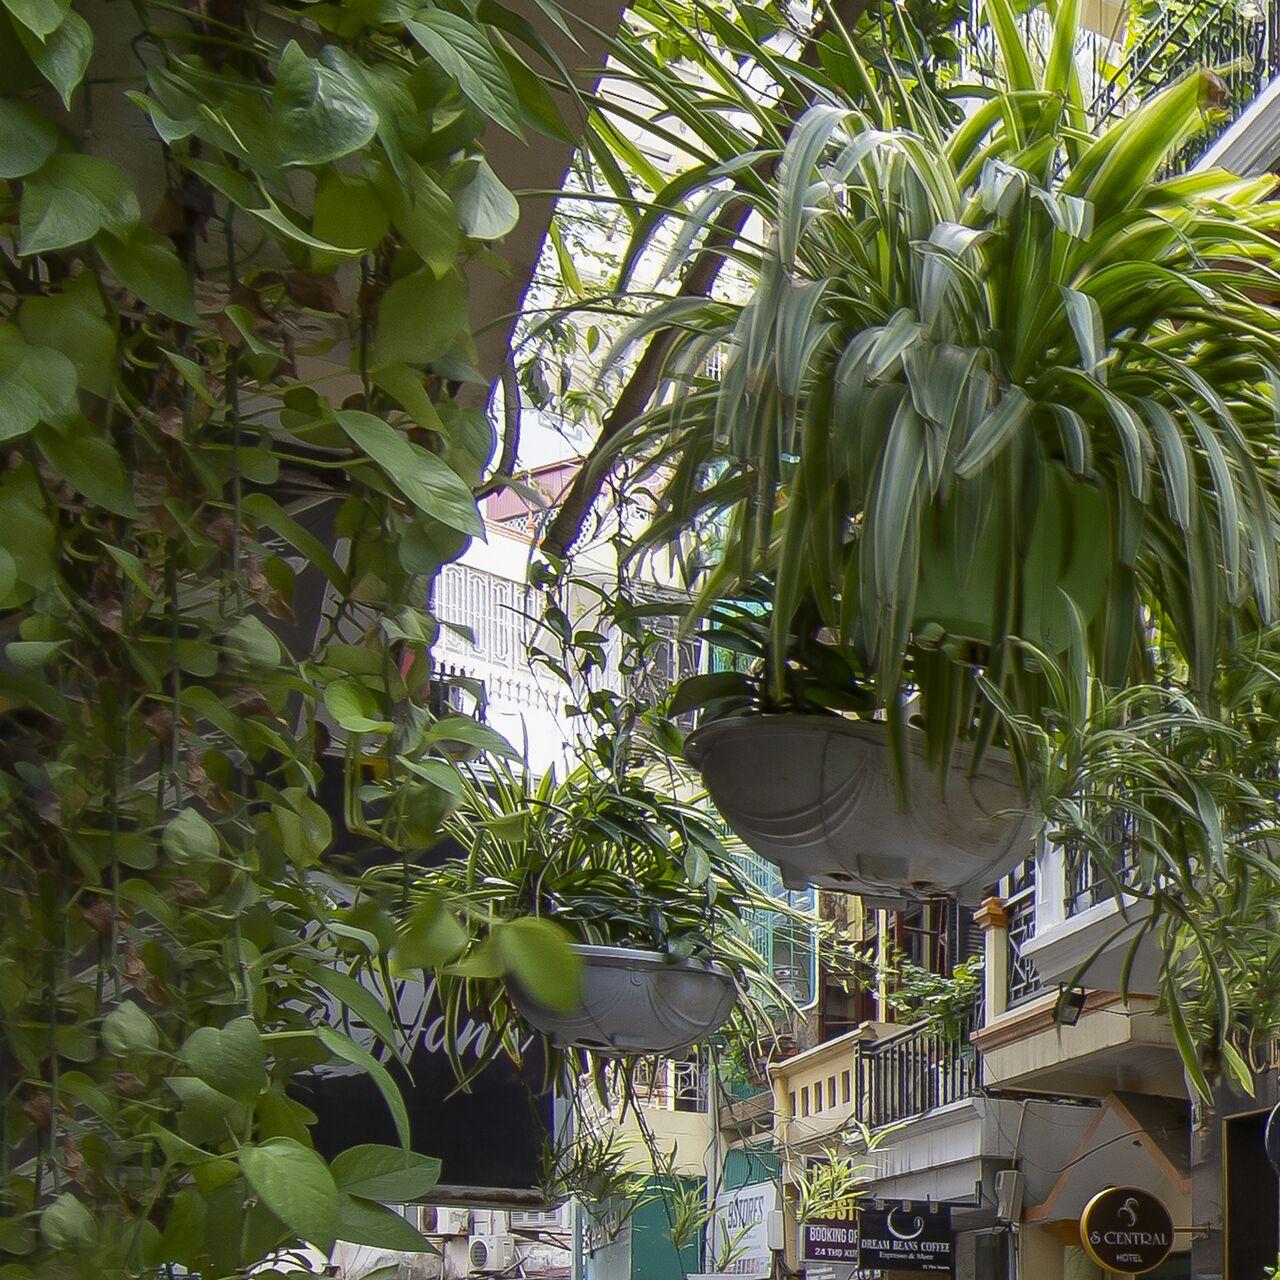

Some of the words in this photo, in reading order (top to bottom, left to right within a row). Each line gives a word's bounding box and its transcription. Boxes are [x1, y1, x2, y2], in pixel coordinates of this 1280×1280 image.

[809, 1227, 847, 1243] BOOKING
[1104, 1231, 1168, 1246] CENTRAL
[815, 1247, 826, 1257] 24
[861, 1239, 890, 1250] DREAM
[893, 1240, 918, 1251] BEANS
[921, 1241, 950, 1253] COFFEE
[1116, 1253, 1143, 1263] HOTEL
